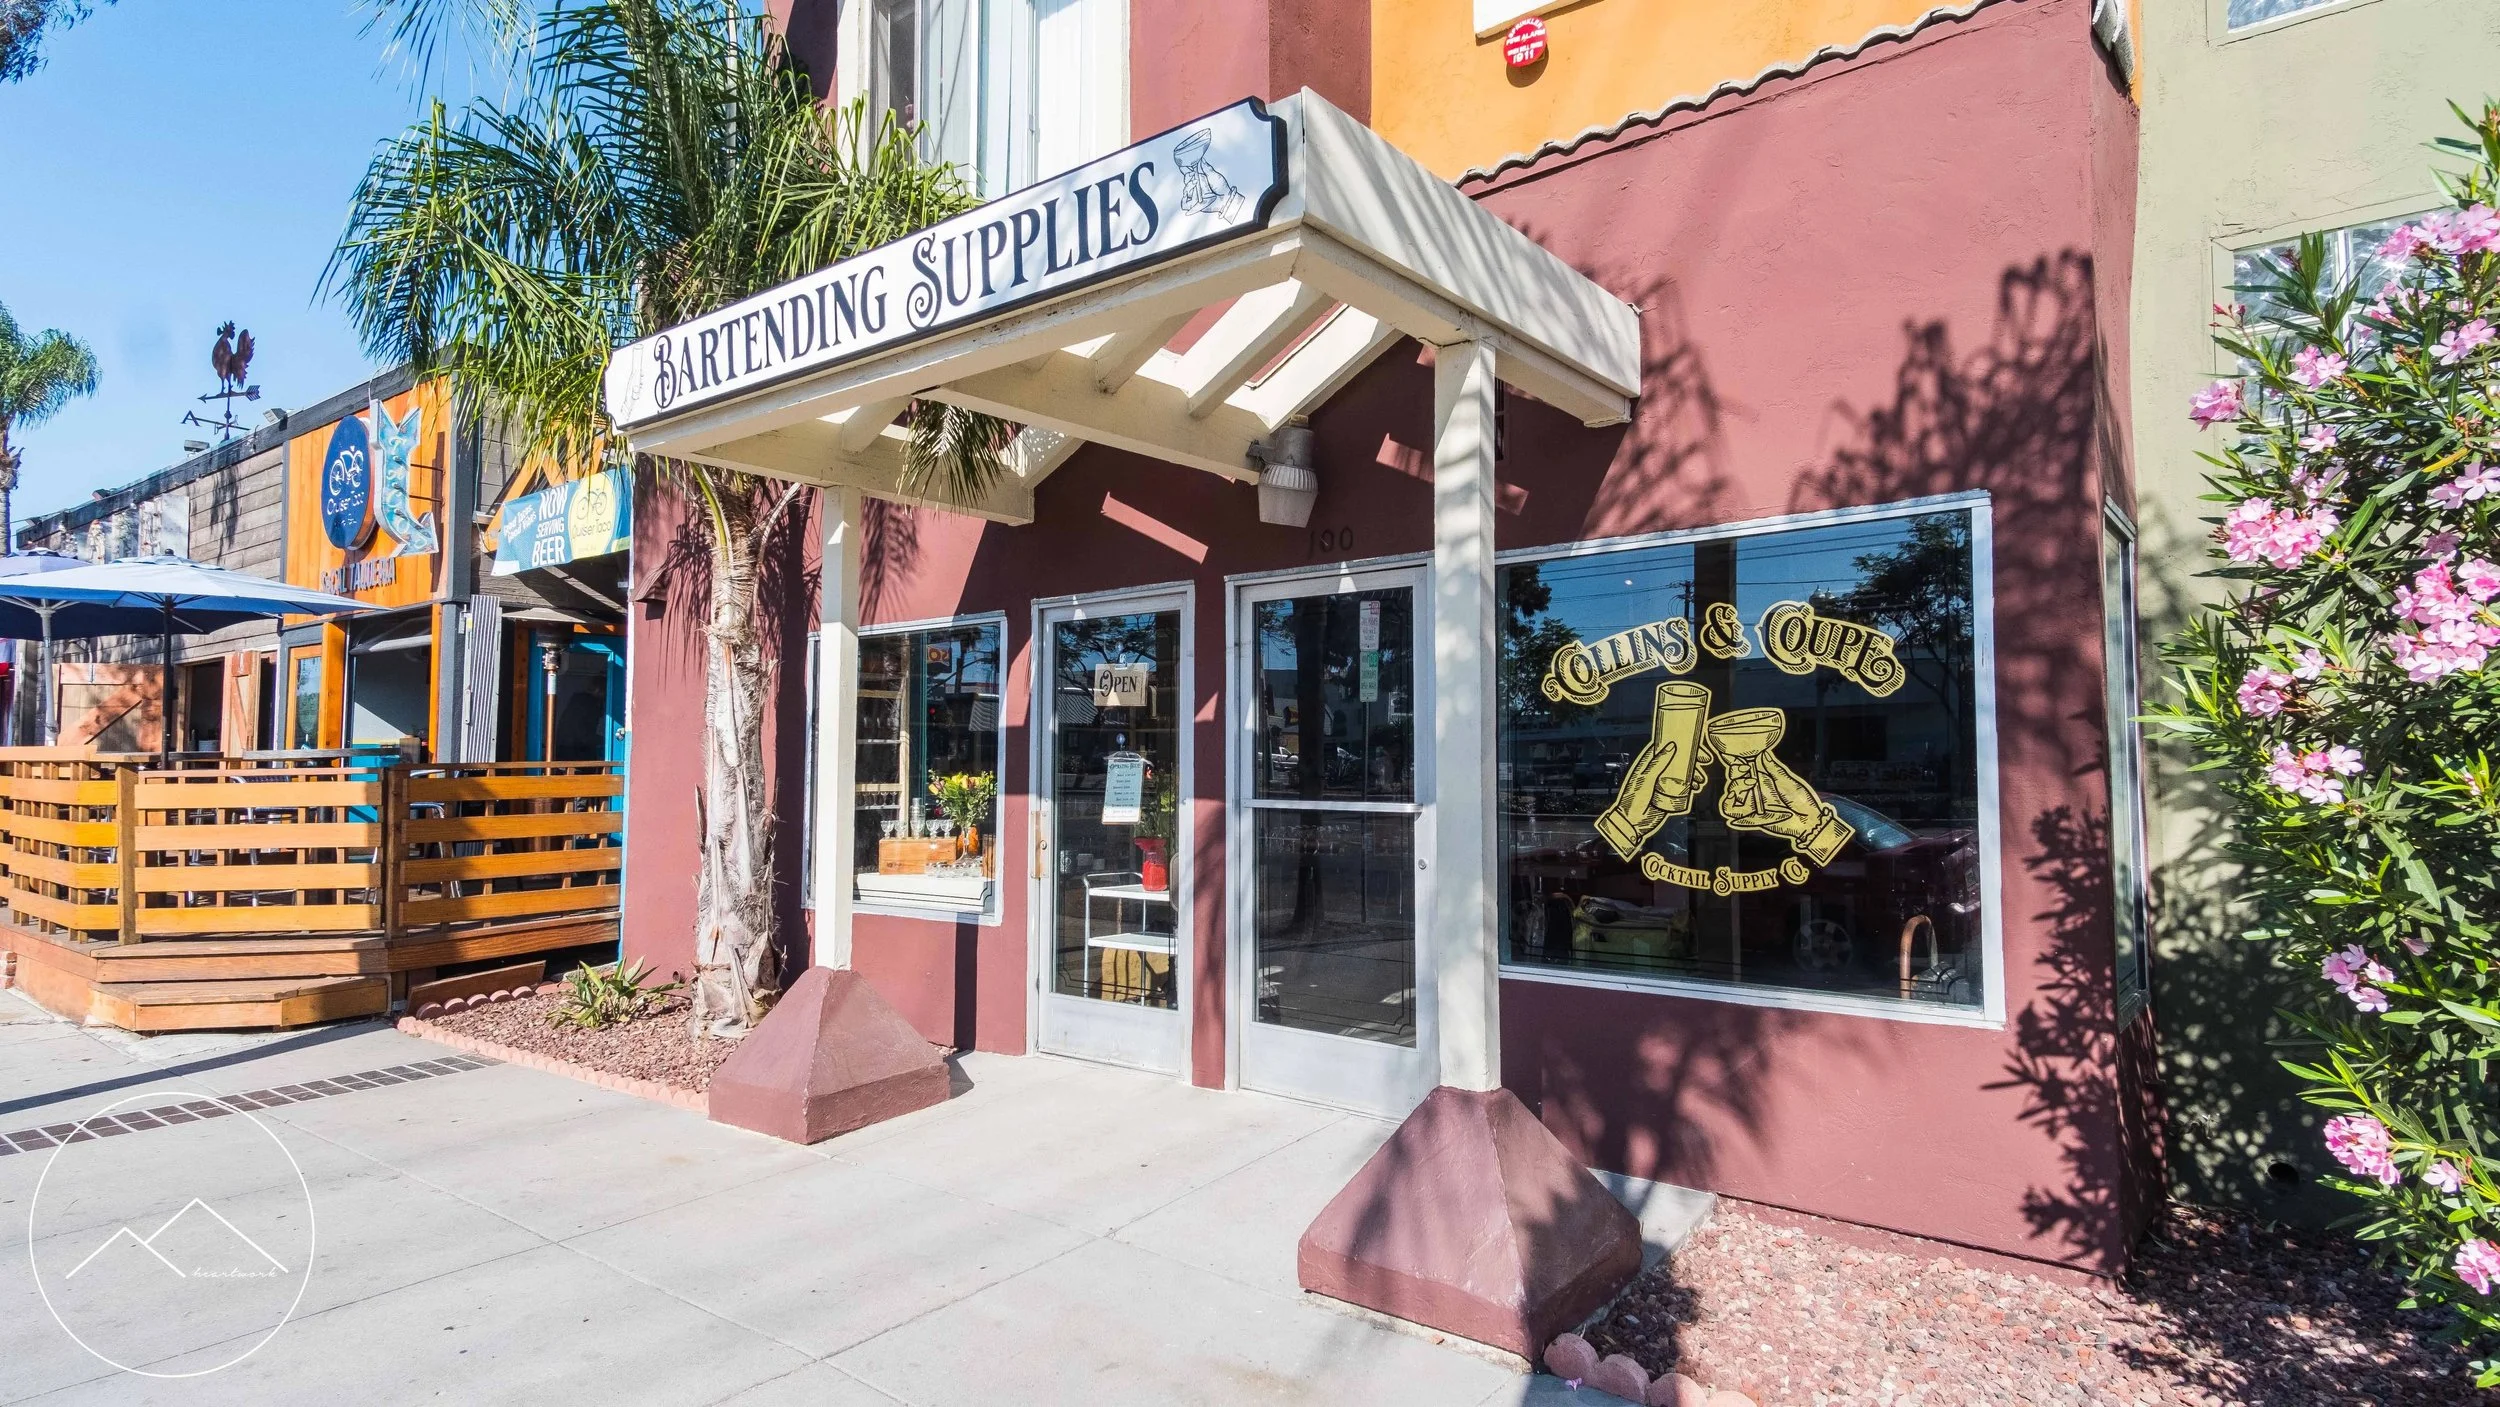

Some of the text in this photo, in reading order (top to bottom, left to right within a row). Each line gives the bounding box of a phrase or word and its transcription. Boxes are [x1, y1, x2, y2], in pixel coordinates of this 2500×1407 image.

[654, 161, 1160, 412] BARTENDING SUPPLIES
[540, 485, 569, 520] NOW
[536, 517, 565, 539] SERVING
[532, 536, 566, 567] BEER
[1543, 601, 1903, 702] COLLINS & COUPE
